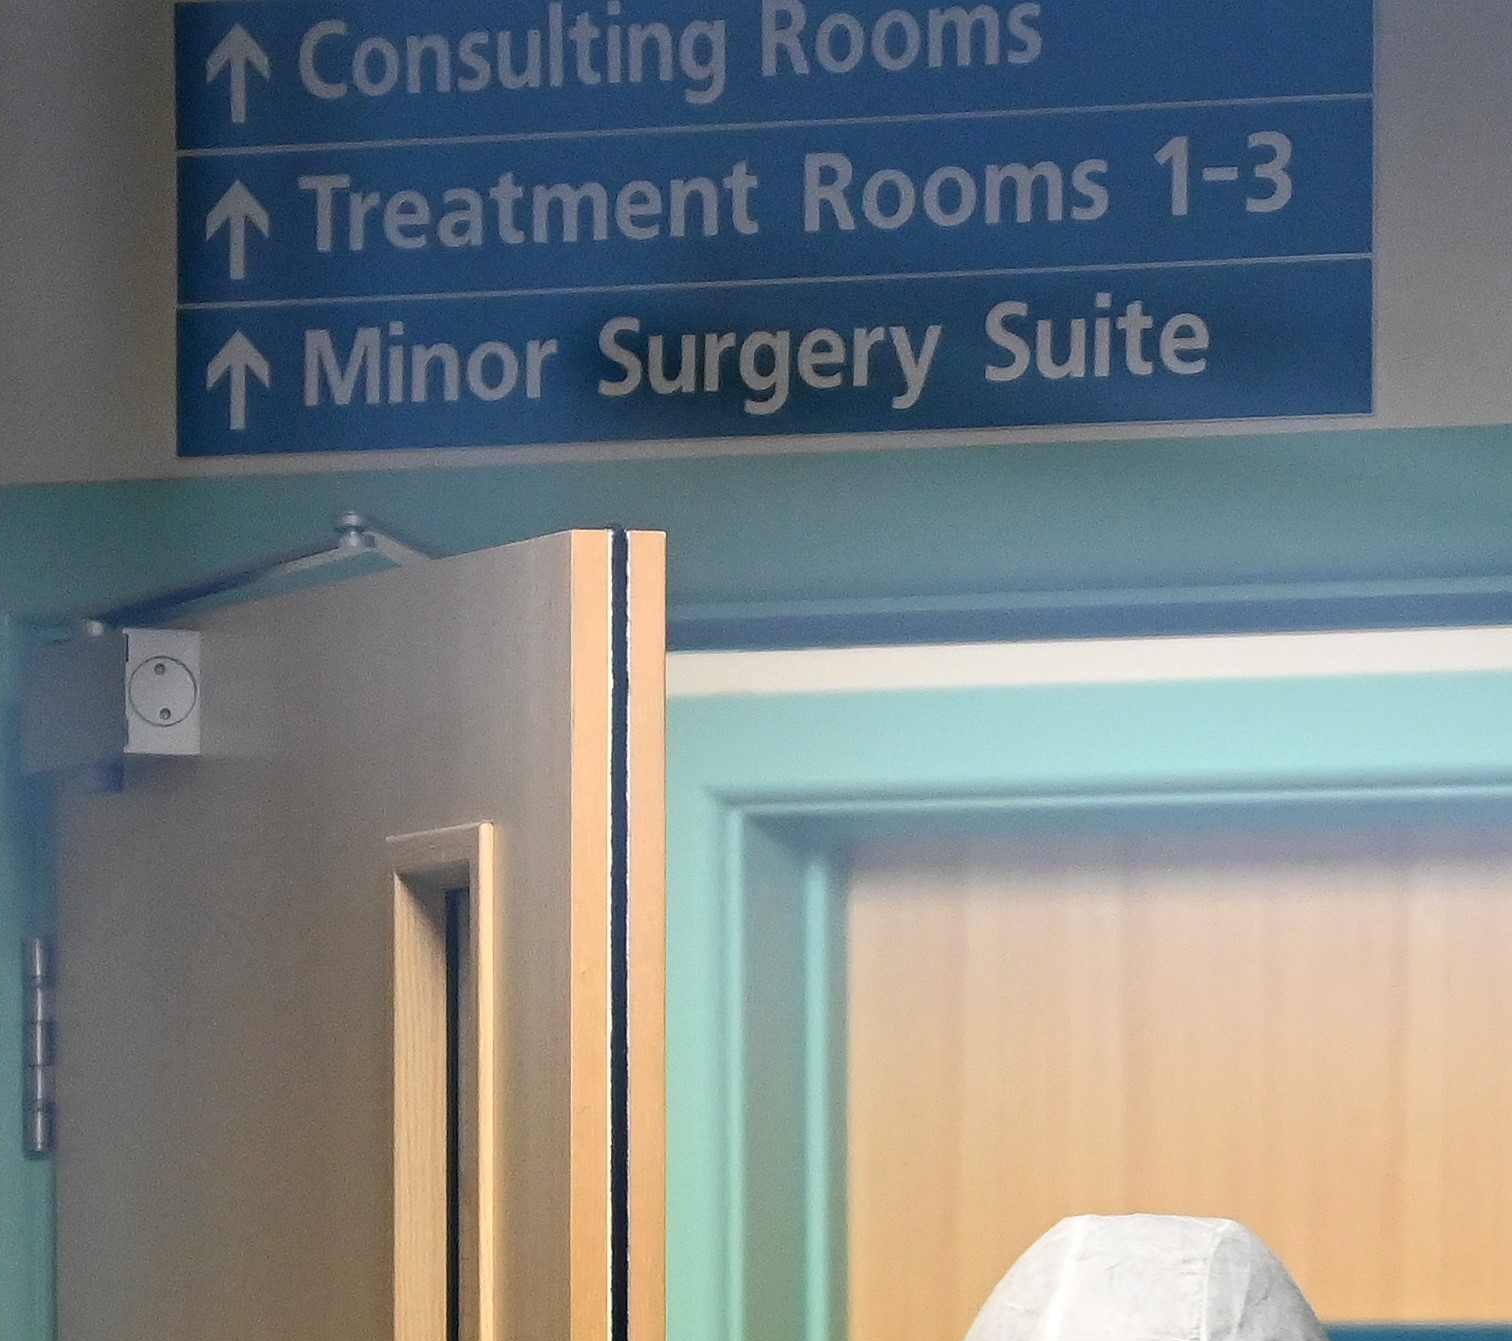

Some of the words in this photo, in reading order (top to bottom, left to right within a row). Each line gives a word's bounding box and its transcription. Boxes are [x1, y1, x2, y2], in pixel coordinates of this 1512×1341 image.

[298, 3, 729, 106] Consulting
[760, 0, 1043, 79] Rooms
[298, 160, 759, 256] Treatment
[803, 149, 1110, 234] Rooms
[1154, 131, 1295, 217] 1-3
[302, 323, 557, 410] Minor
[597, 312, 942, 417] Surgery
[984, 295, 1212, 384] Suite
